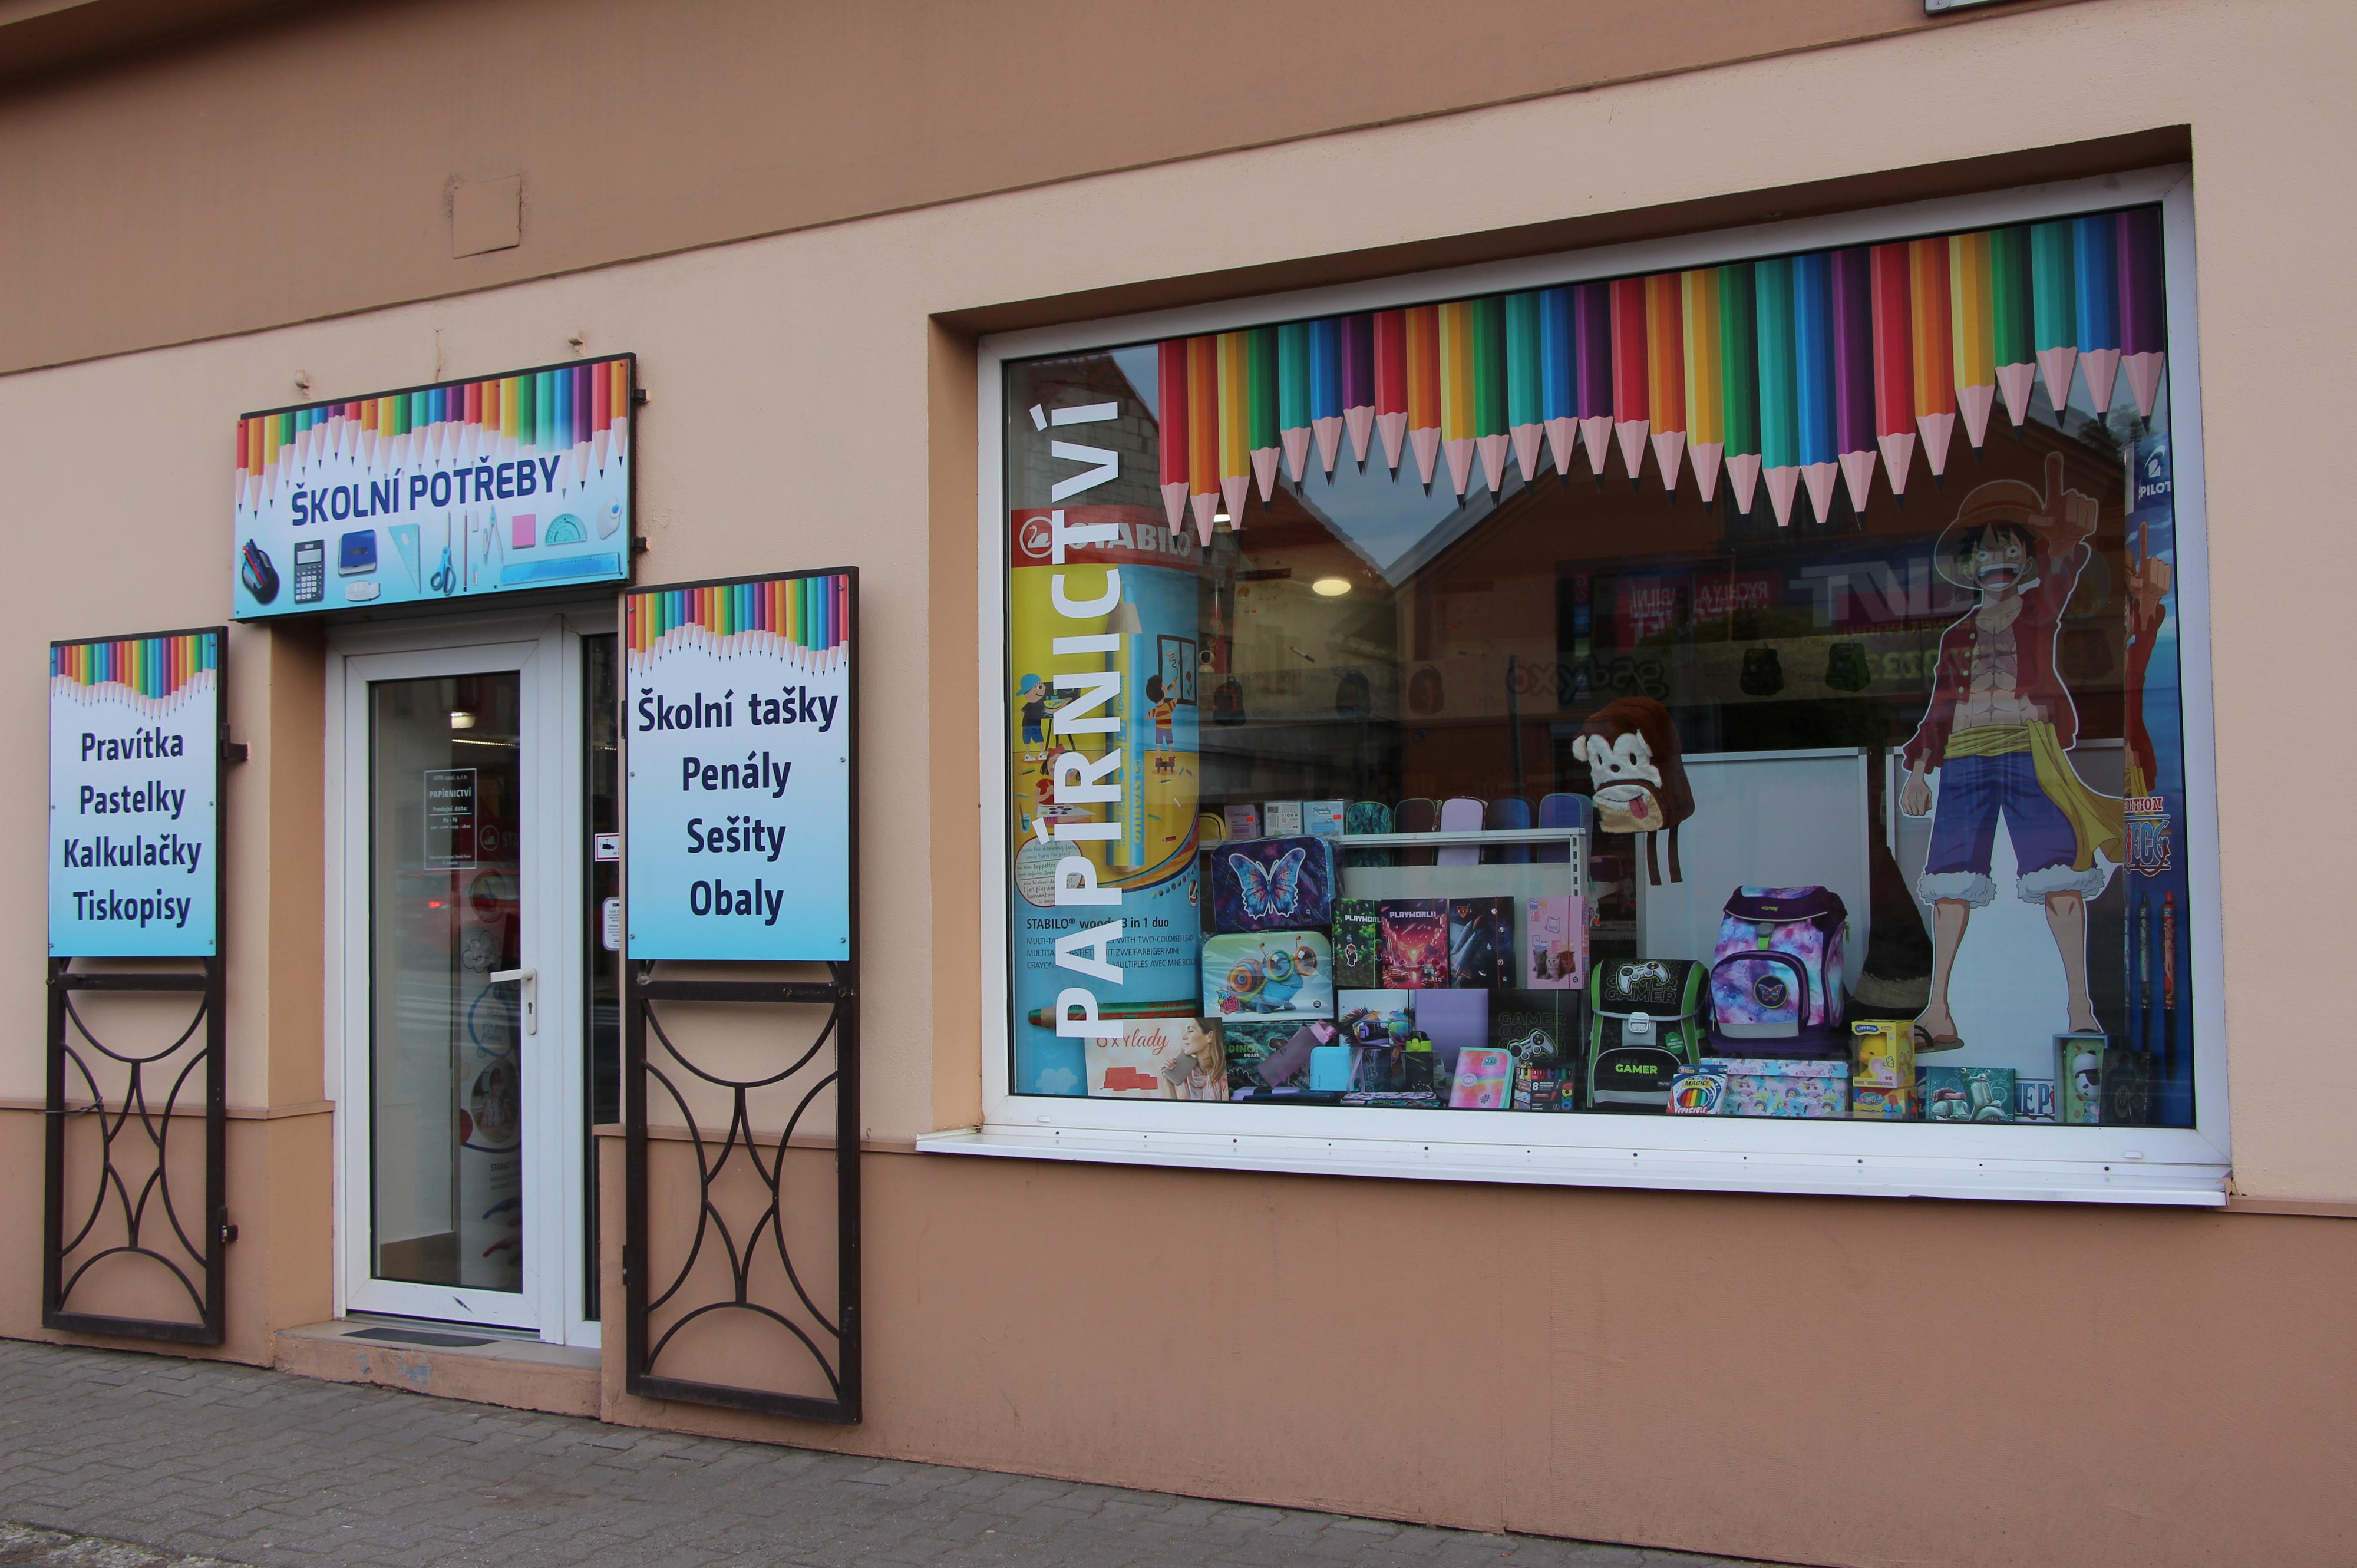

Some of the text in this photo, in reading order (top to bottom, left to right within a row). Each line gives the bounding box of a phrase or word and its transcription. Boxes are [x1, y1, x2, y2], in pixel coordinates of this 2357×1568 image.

[292, 455, 561, 526] ŠKOLNÍ POTŘEBY
[2138, 480, 2171, 499] PILOT
[639, 685, 839, 732] Školní tašky
[1029, 401, 1124, 1038] PAPÍRNICTVÍ
[82, 727, 184, 762] Pravítka
[682, 750, 792, 798] Penály
[81, 780, 186, 820] Pastelky
[429, 787, 472, 798] PAPÍRNICTVÍ
[2124, 797, 2163, 813] DITION
[687, 814, 787, 862] Sešity
[64, 833, 202, 874] Kalkulačky
[72, 888, 192, 928] Tiskopisy
[690, 879, 784, 926] Obaly
[1131, 917, 1140, 928] in
[1143, 917, 1147, 927] 1
[1152, 917, 1169, 928] duo
[1345, 915, 1381, 923] PLAYWORL
[1115, 948, 1164, 956] ZWEIFARBIGER
[1138, 935, 1182, 943] TWO-COLORED
[1498, 1011, 1567, 1026] GAMER
[1615, 1064, 1658, 1074] GAMER
[1532, 1082, 1539, 1091] 8
